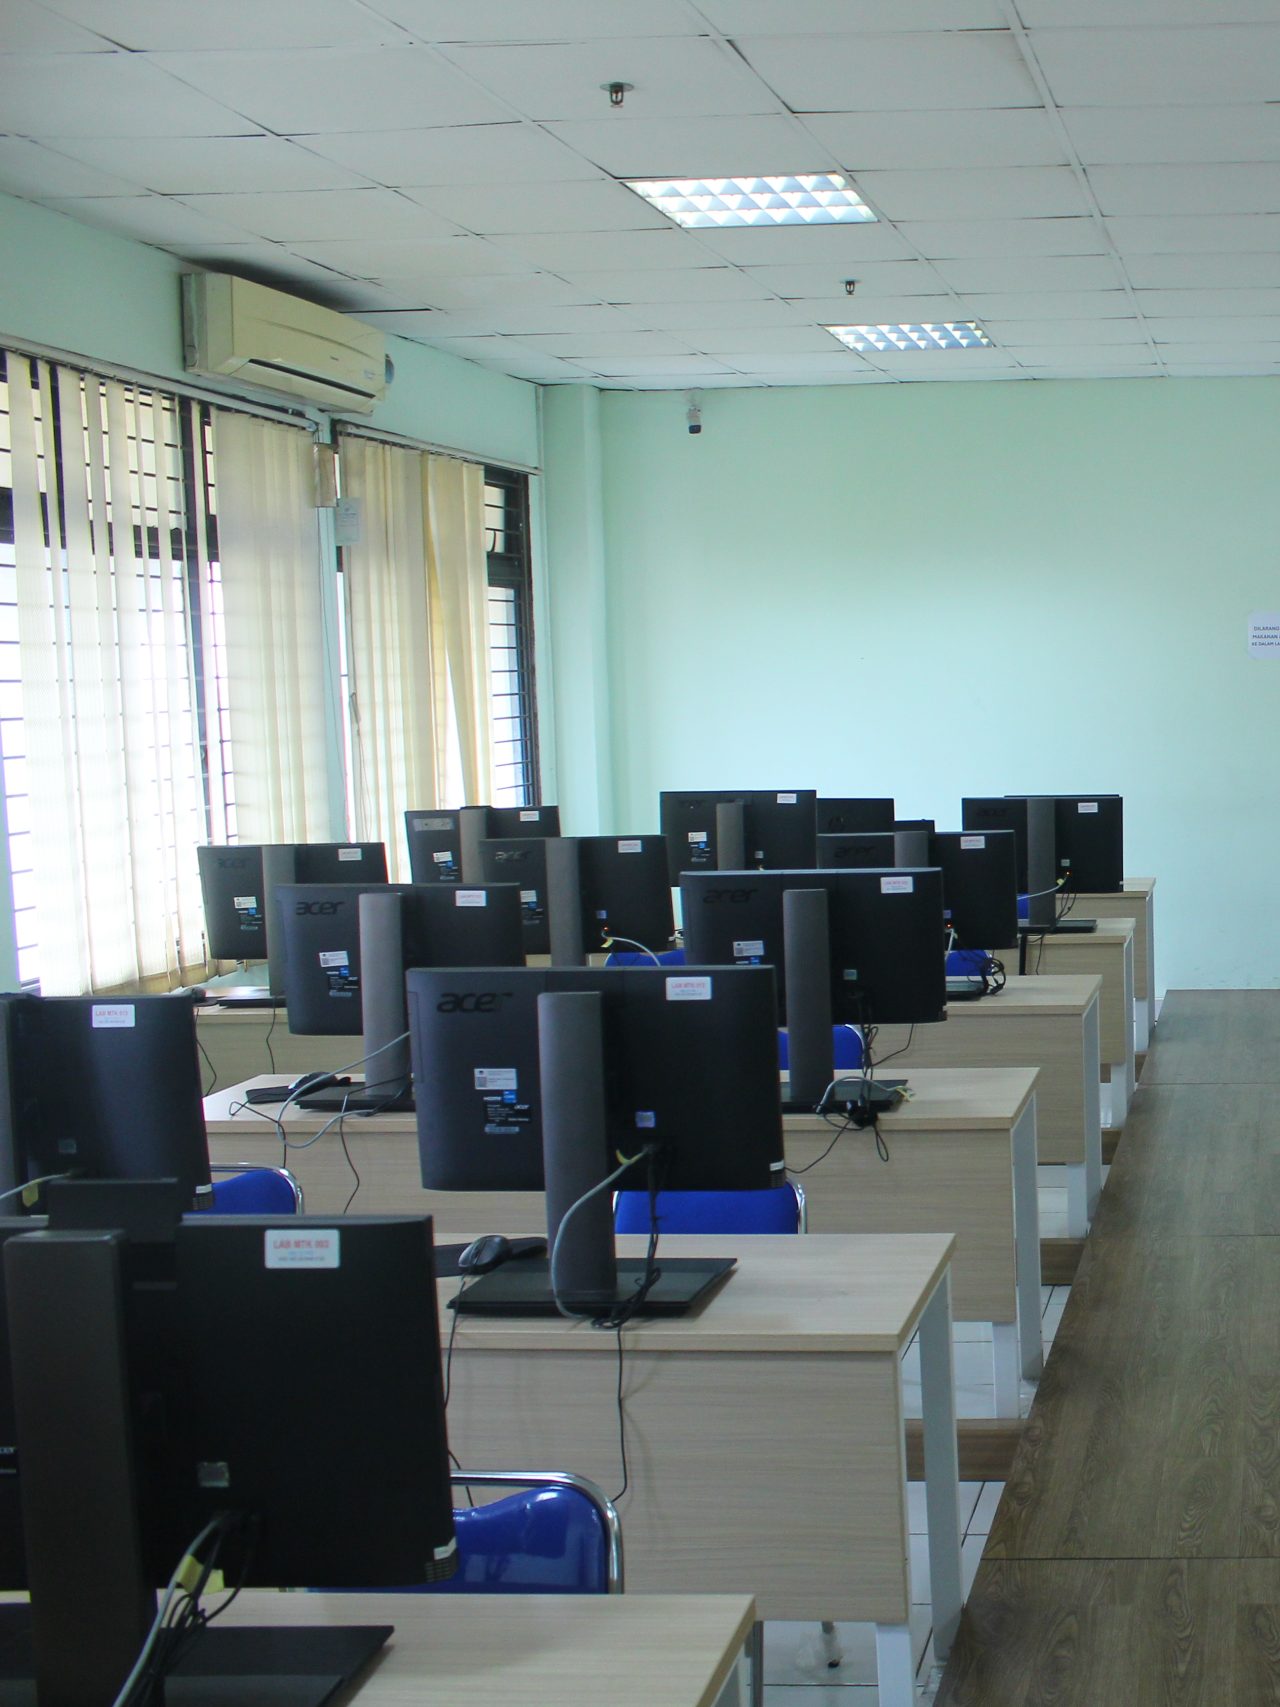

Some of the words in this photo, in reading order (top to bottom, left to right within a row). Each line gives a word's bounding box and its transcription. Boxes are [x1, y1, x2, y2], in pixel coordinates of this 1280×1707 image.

[296, 901, 344, 916] acer
[273, 1239, 291, 1250] LAB
[293, 1239, 314, 1249] MTK
